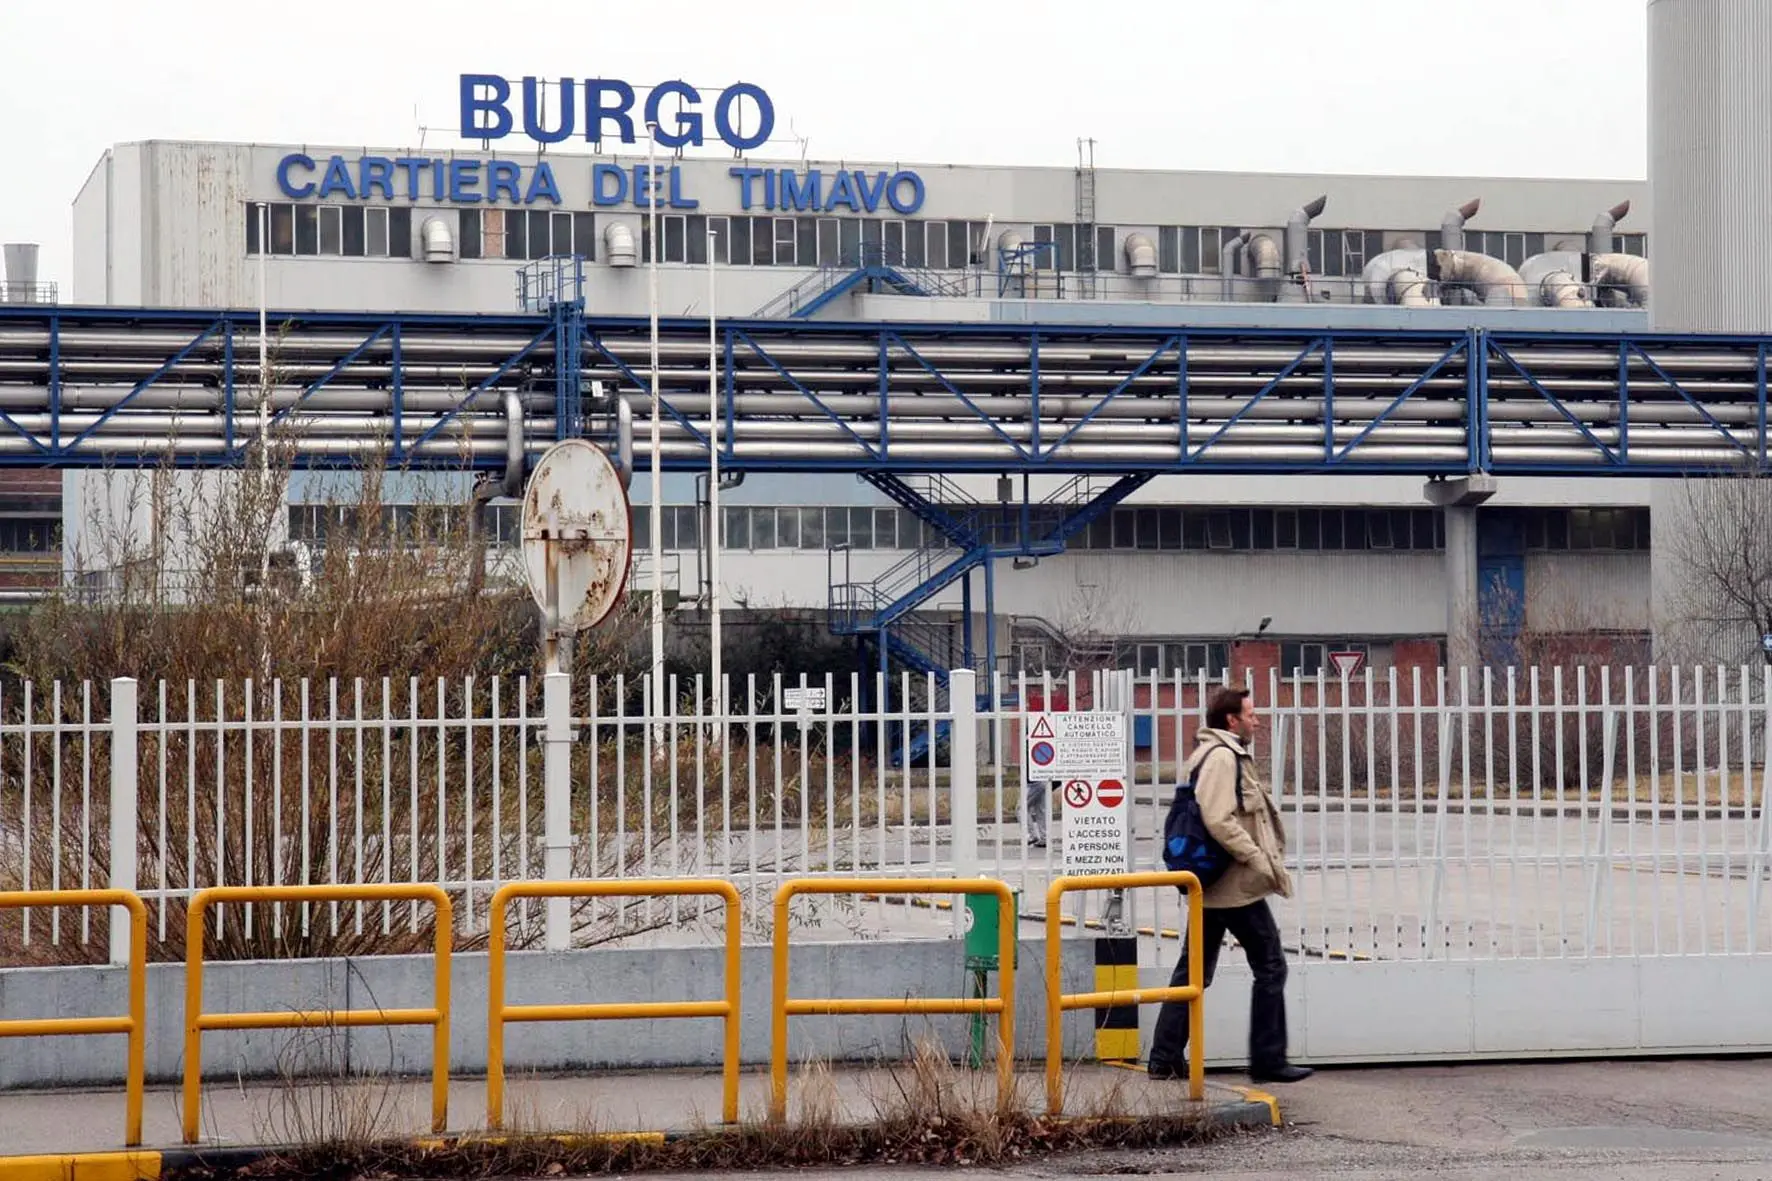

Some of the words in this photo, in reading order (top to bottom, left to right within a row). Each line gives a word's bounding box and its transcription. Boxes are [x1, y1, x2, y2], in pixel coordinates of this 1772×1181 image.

[460, 75, 774, 149] BURGO
[277, 154, 561, 204] CARTIERA
[594, 163, 698, 208] DEL
[730, 167, 926, 215] TIMAVO
[1074, 816, 1116, 825] VIETATO
[1068, 830, 1121, 839] L'ACCESSO
[1070, 843, 1076, 851] A
[1078, 842, 1121, 851] PERSONE
[1066, 856, 1072, 864] E
[1075, 855, 1102, 864] MEZZI
[1105, 855, 1124, 863] NON
